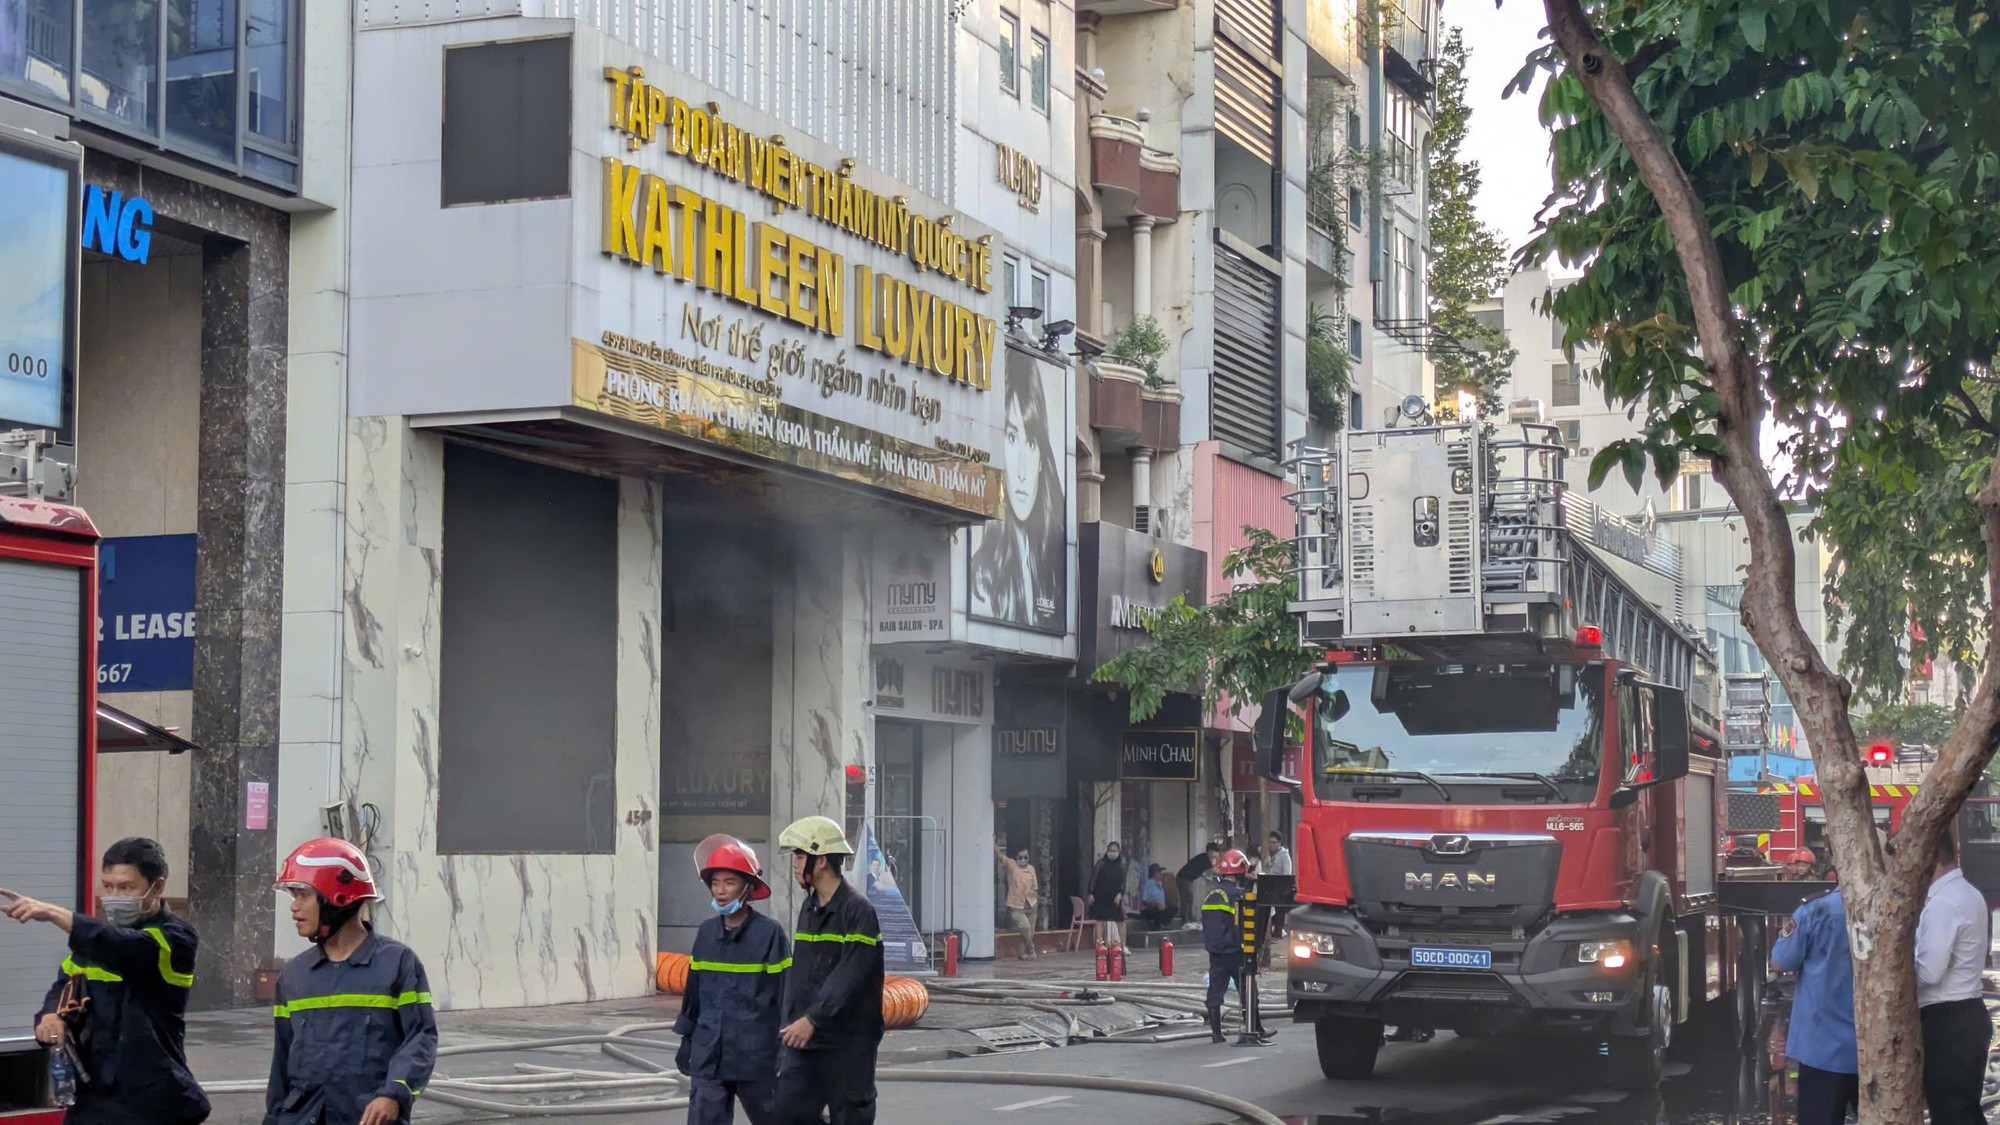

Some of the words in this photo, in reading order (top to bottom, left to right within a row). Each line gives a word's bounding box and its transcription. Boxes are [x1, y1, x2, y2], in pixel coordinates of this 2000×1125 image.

[604, 65, 666, 151] TẬP
[665, 101, 745, 183] ĐOÀN
[746, 134, 805, 215] VIỆN
[806, 157, 874, 242] THẨM
[875, 195, 910, 255] MỸ
[910, 214, 967, 281] QUỐC
[966, 234, 993, 294] TẾ
[602, 156, 845, 338] KATHLEEN
[854, 264, 996, 391] LUXURY
[8, 352, 48, 379] 000
[681, 302, 723, 350] Nơi
[728, 318, 765, 362] thế
[767, 338, 807, 380] giới
[811, 349, 863, 398] ngắm
[867, 368, 906, 410] nhìn
[910, 380, 942, 425] bạn
[607, 368, 665, 407] PHÒNG
[717, 399, 773, 439] CHUYÊN
[777, 418, 812, 450] KHOA
[814, 426, 850, 461] THẨM
[853, 439, 871, 466] MỸ
[907, 457, 937, 485] KHOA
[938, 462, 969, 494] THẨM
[970, 474, 986, 497] MỸ
[115, 612, 196, 641] LEASE
[880, 621, 897, 632] HAIR
[899, 620, 922, 631] SALON
[929, 619, 944, 630] SPA
[1124, 744, 1157, 762] MINH
[1160, 743, 1194, 763] CHAU
[675, 768, 770, 794] LUXURY
[1405, 872, 1496, 892] MAN
